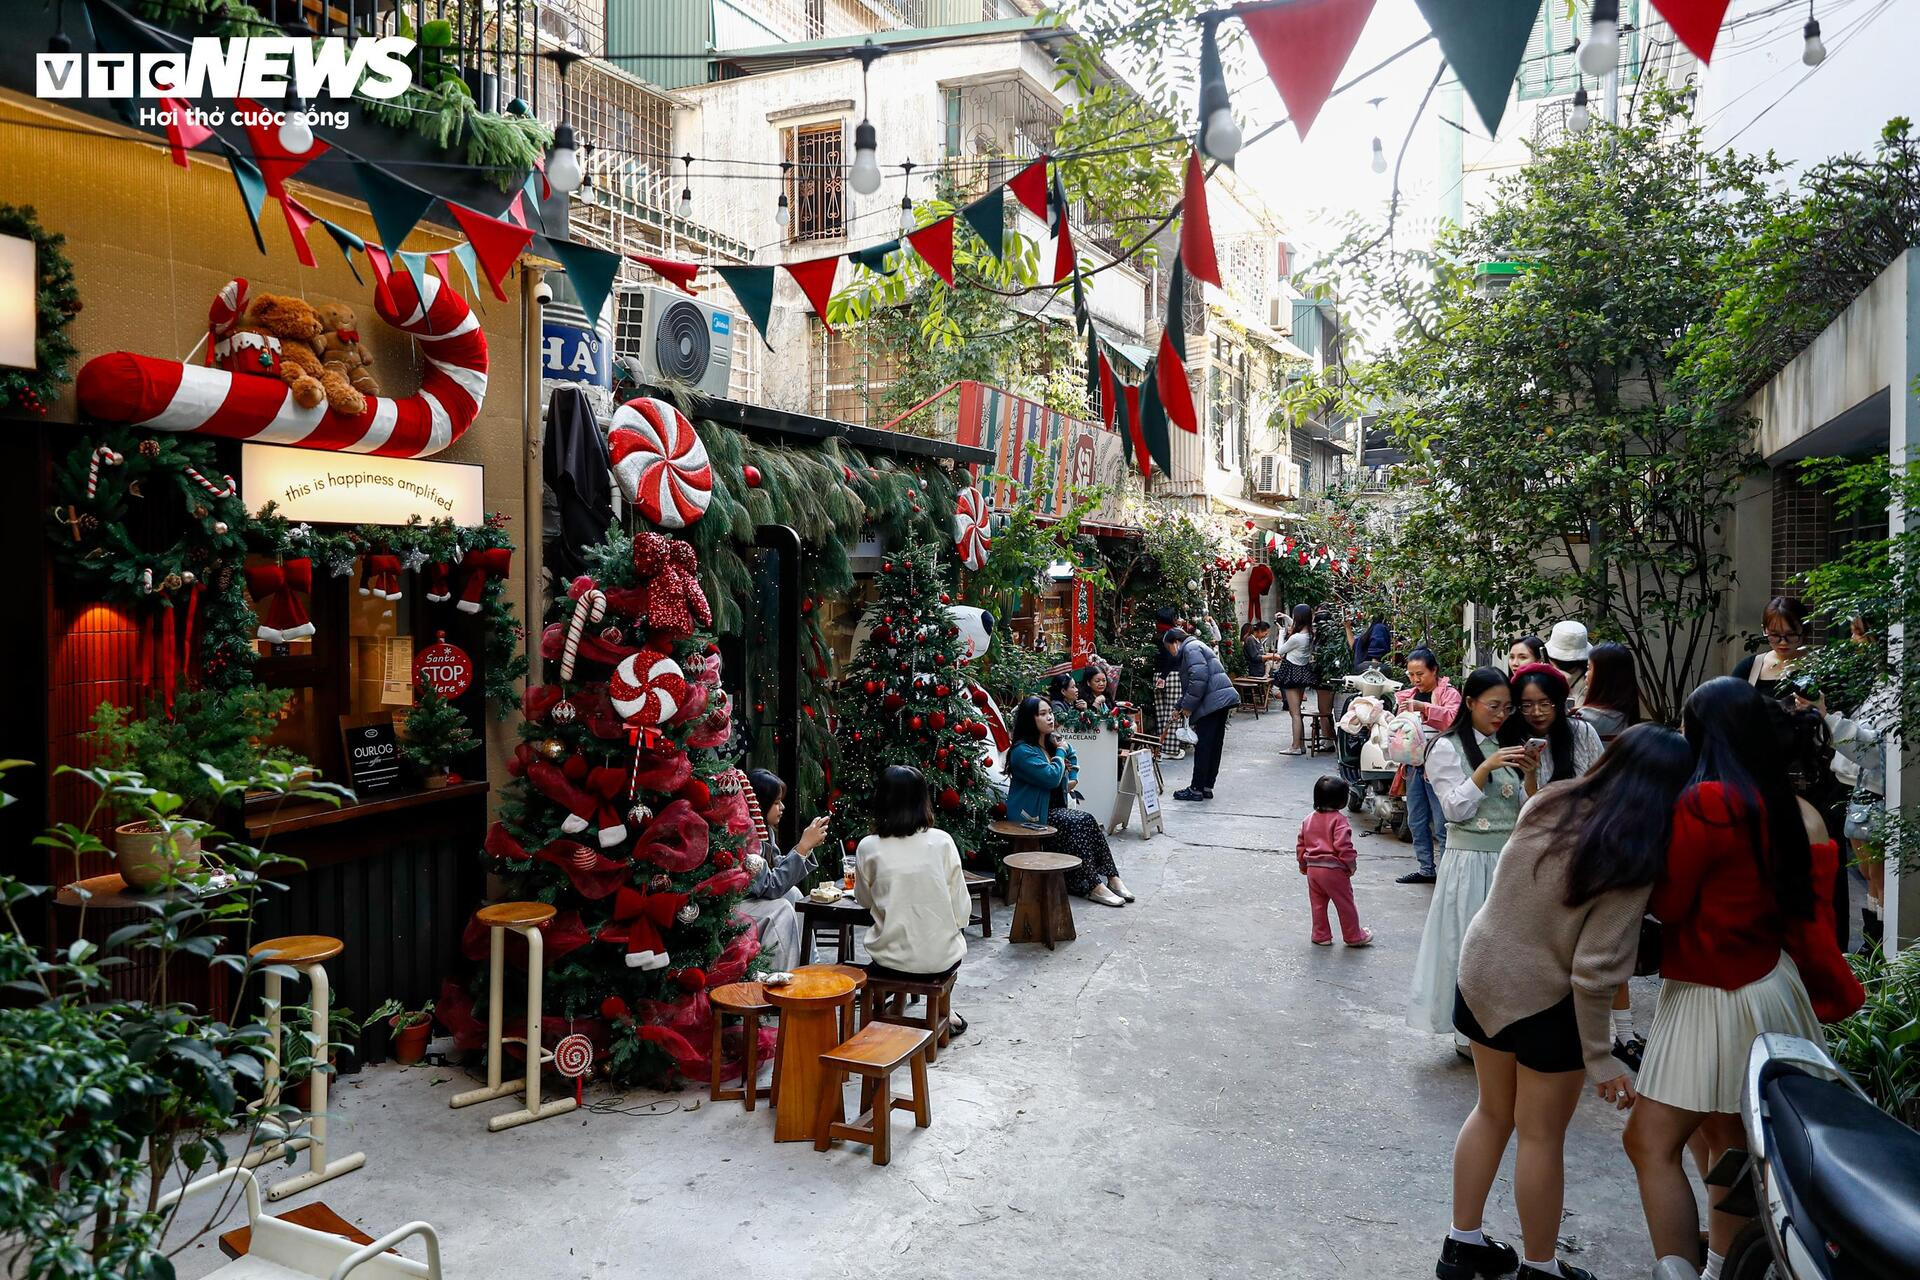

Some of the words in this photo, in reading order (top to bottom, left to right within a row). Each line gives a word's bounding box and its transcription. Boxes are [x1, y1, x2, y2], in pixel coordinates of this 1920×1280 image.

[285, 484, 311, 502] this
[313, 478, 325, 491] is
[327, 472, 394, 489] happiness
[397, 479, 454, 511] amplified
[425, 653, 456, 664] Santa
[420, 665, 464, 682] STOP
[354, 743, 394, 758] OURLOG
